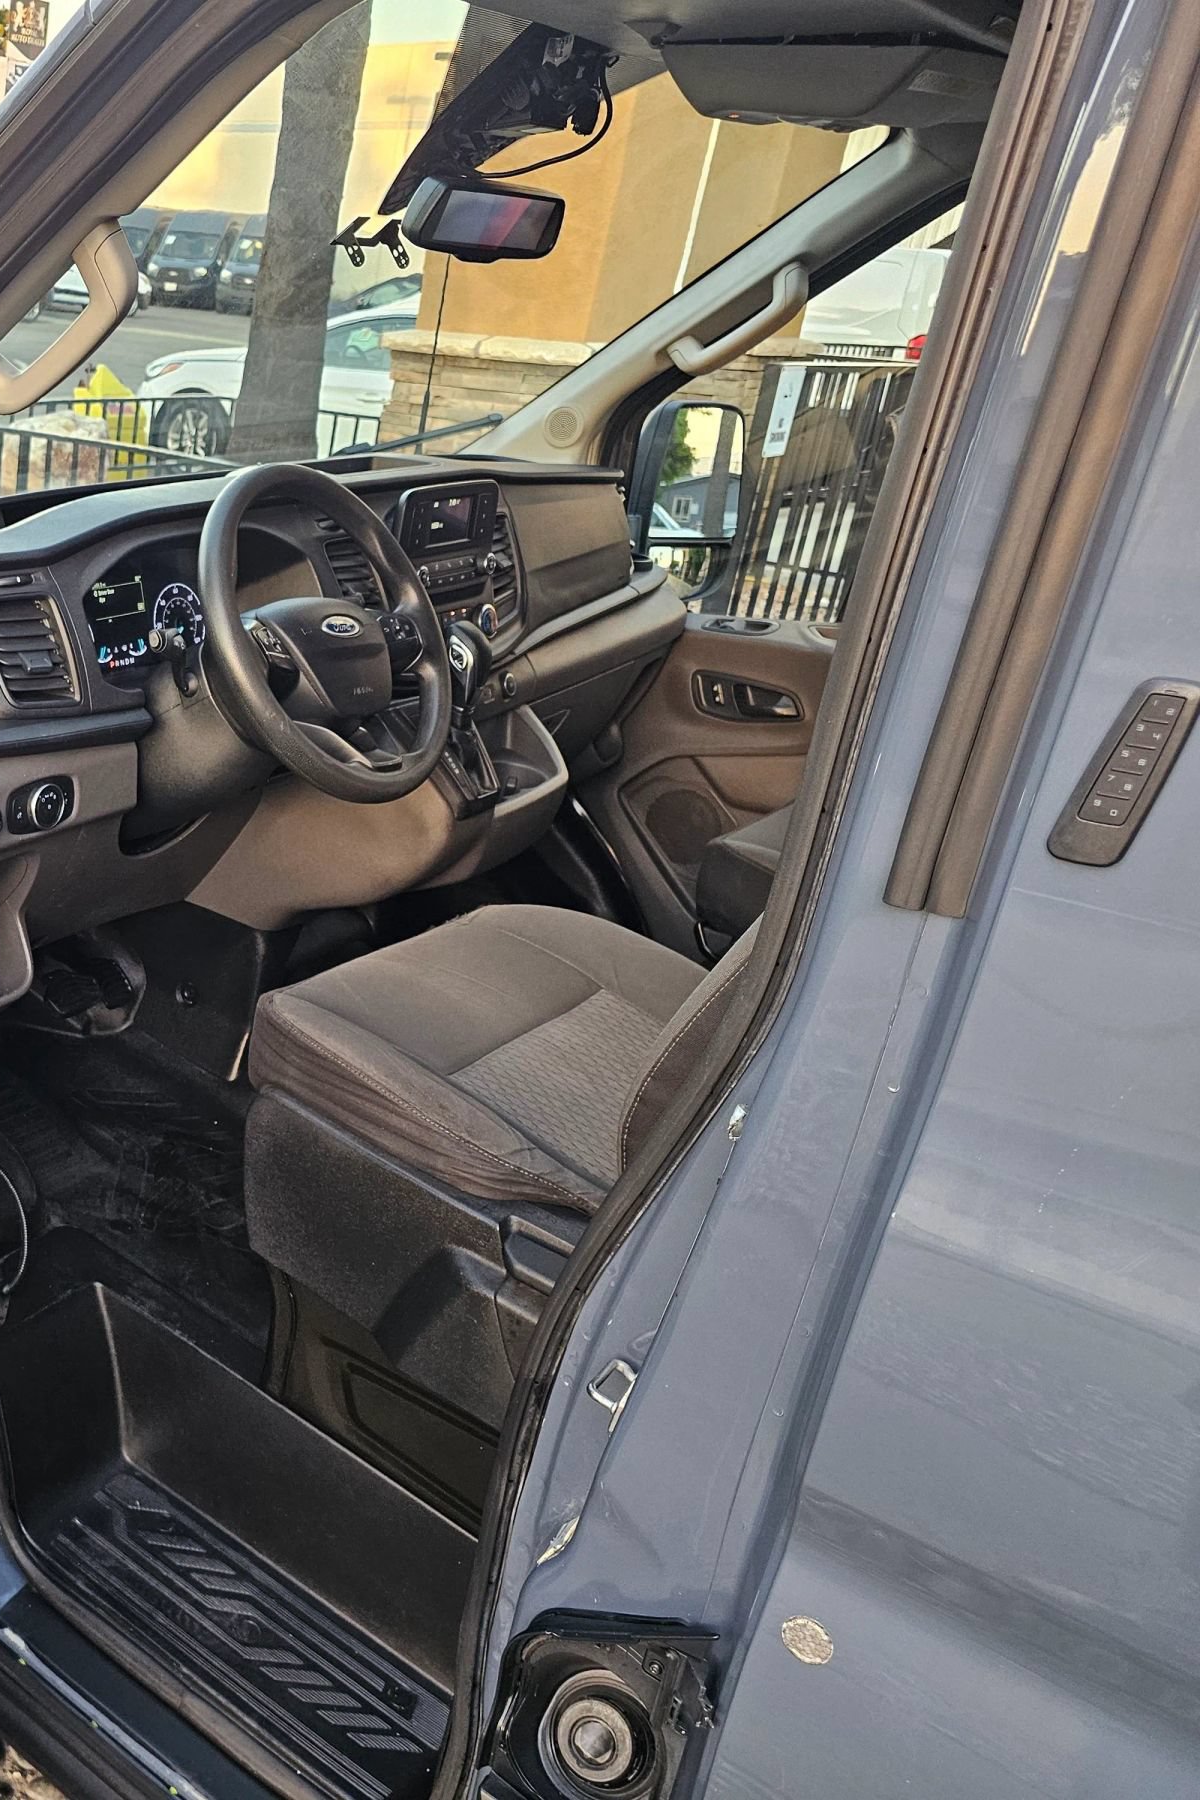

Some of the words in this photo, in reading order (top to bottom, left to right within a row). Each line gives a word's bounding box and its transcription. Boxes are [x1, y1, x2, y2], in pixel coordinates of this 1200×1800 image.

[1165, 708, 1175, 716] 2
[1136, 724, 1145, 732] 3
[1152, 732, 1161, 740] 4
[1120, 750, 1130, 758] 5
[1137, 758, 1147, 766] 6
[1107, 774, 1116, 782] 7
[1123, 783, 1133, 791] 8
[1093, 799, 1102, 807] 9
[1109, 809, 1118, 817] 0
